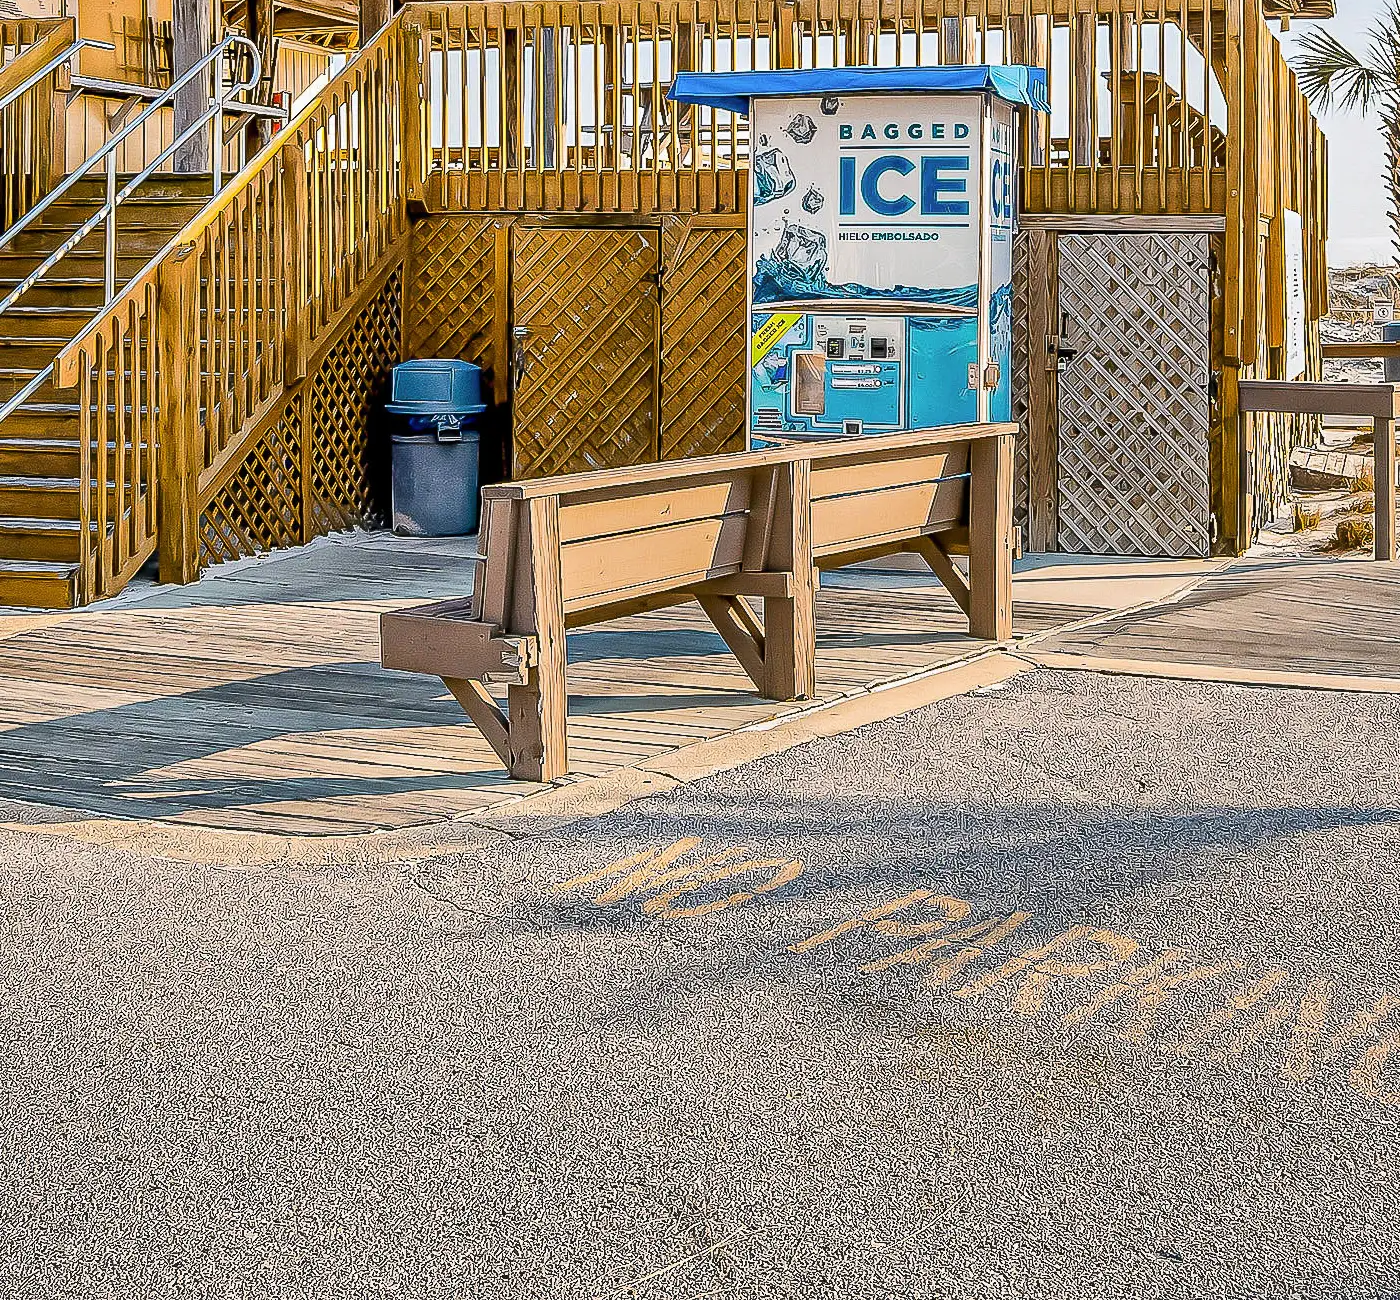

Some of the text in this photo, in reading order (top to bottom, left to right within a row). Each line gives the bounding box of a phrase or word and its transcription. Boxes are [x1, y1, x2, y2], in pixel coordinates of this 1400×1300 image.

[839, 123, 970, 140] BAGGED
[839, 155, 970, 216] ICE
[992, 159, 1010, 218] CE
[838, 232, 939, 241] HIELO EMBOLSADO
[553, 836, 803, 918] NO
